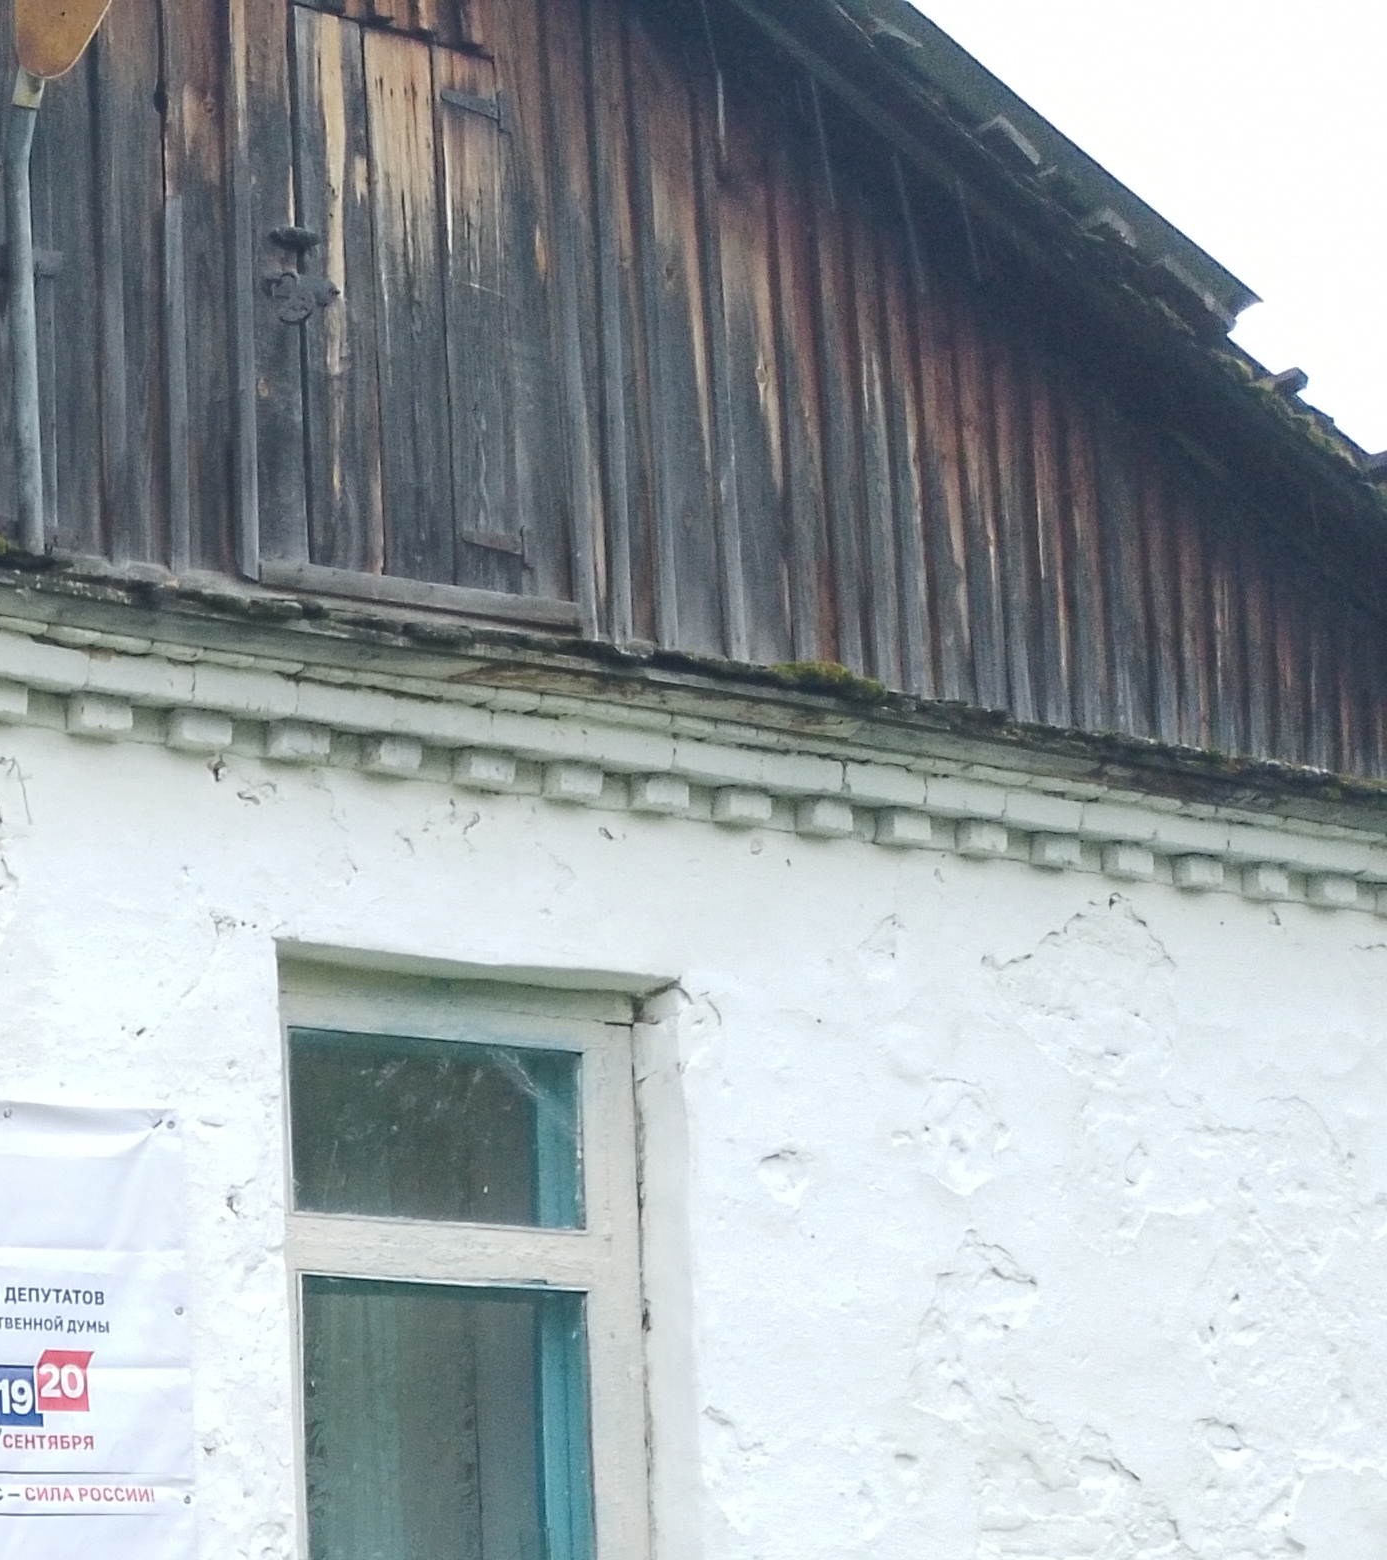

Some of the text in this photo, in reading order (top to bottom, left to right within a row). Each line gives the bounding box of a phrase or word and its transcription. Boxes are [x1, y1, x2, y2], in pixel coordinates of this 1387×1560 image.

[4, 1287, 104, 1305] ДЕПУТАТОВ
[67, 1318, 110, 1334] ДУМЫ
[40, 1364, 85, 1399] 20
[3, 1434, 94, 1450] СЕНТЯБРЯ
[25, 1487, 74, 1501] СИЛА
[78, 1487, 155, 1502] РОССИИ!
